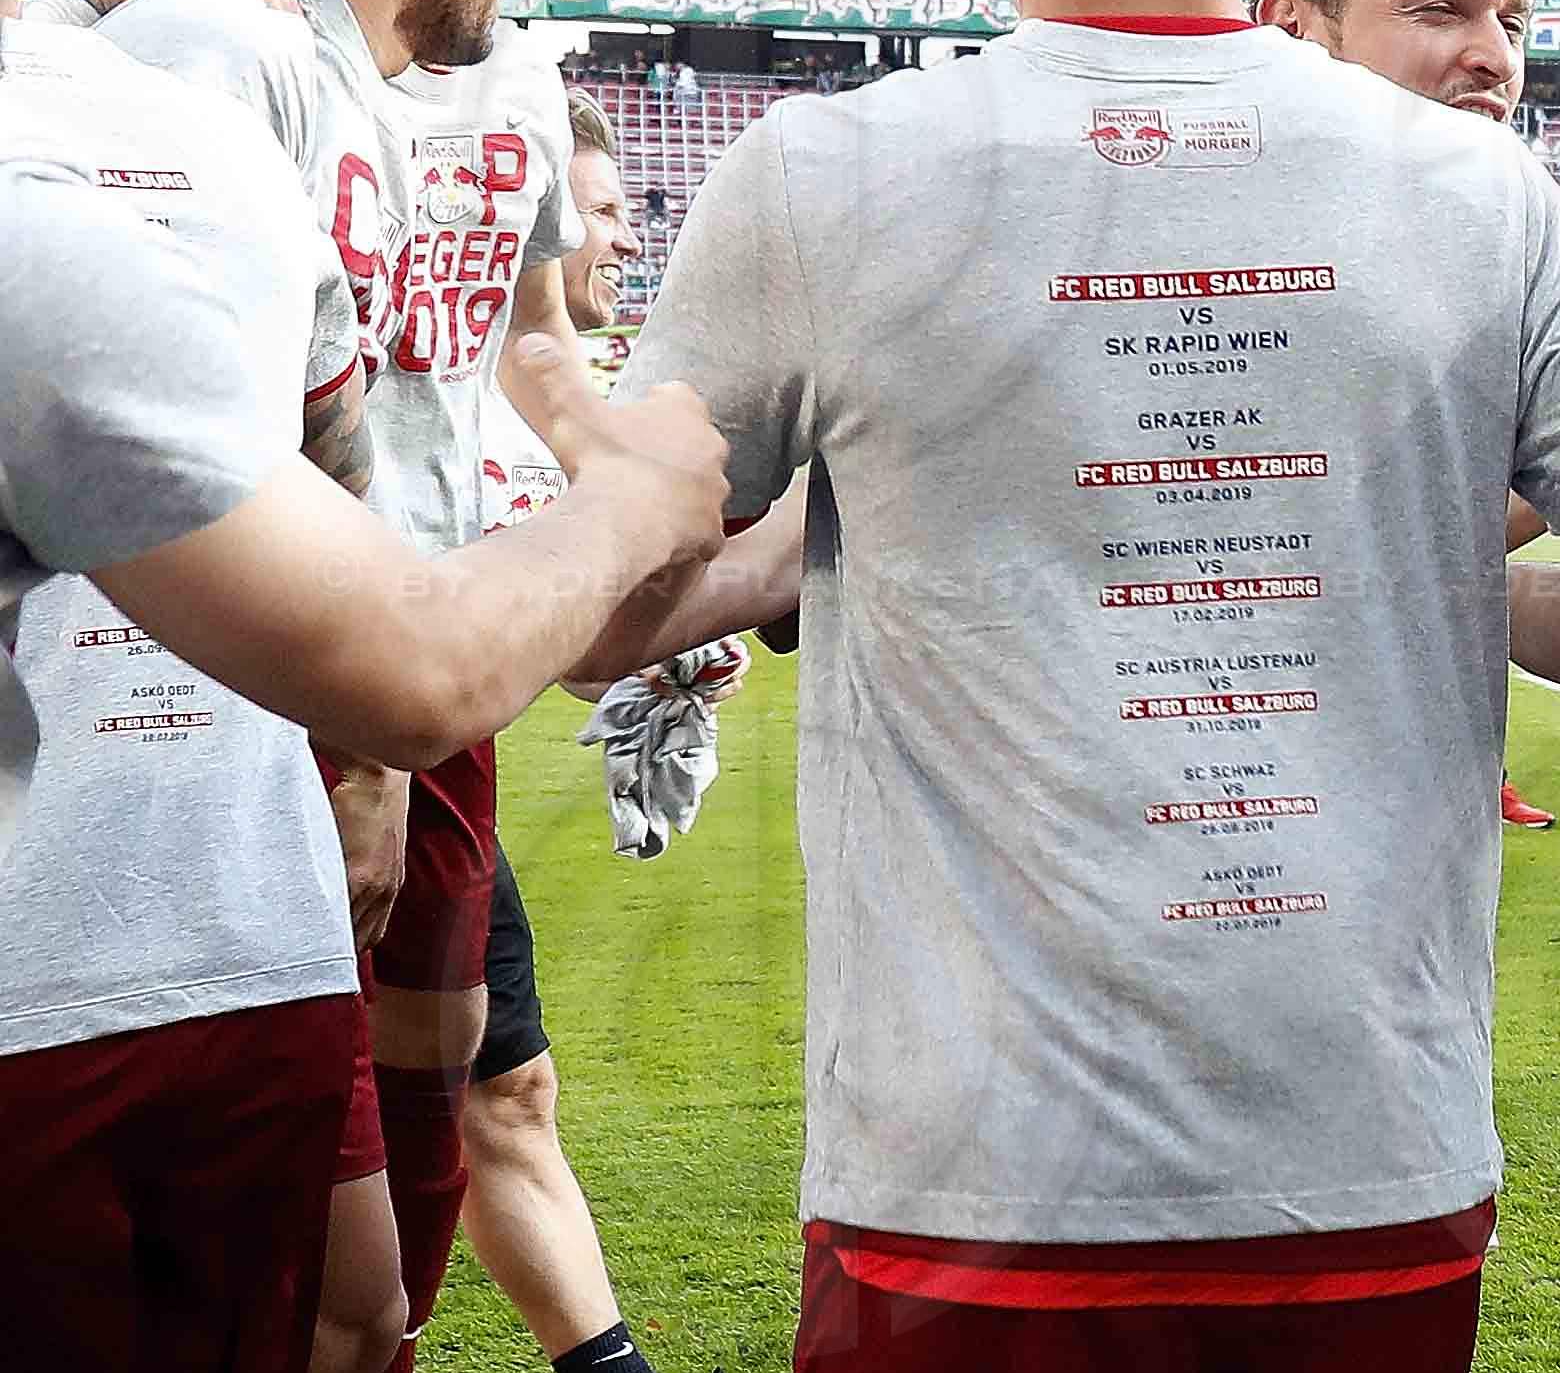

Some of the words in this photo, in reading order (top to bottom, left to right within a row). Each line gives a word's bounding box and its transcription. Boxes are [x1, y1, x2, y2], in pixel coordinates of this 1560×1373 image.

[1185, 137, 1250, 150] MORGEN
[1051, 278, 1080, 299] FC
[1089, 278, 1136, 298] RED
[1143, 276, 1202, 296] BULL
[1209, 270, 1332, 293] SALZBURG
[1180, 307, 1213, 325] VS
[396, 288, 506, 372] 019
[1106, 338, 1136, 356] SK
[1148, 335, 1218, 354] RAPID
[1229, 330, 1288, 350] WIEN
[1150, 358, 1247, 376] 01.05.2019
[1139, 411, 1225, 430] GRAZER
[1234, 409, 1263, 425] AK
[1187, 435, 1216, 450] VS
[1077, 466, 1105, 484] FC
[1112, 465, 1151, 483] RED
[1159, 461, 1211, 480] BULL
[1216, 457, 1325, 477] SALZBURG
[1157, 487, 1252, 505] 03.04.2019
[1103, 543, 1128, 558] SC
[1136, 539, 1207, 556] WIENER
[1214, 535, 1311, 553] NEUSTADT
[1197, 561, 1223, 573] VS
[1101, 589, 1126, 605] FC
[1131, 587, 1167, 603] RED
[1172, 584, 1218, 602] BULL
[1223, 579, 1318, 599] SALZBURG
[75, 633, 95, 645] FC
[98, 631, 125, 643] RED
[168, 685, 196, 695] OEDT
[159, 700, 173, 709] VS
[96, 720, 114, 731] FC
[117, 719, 141, 729] RED
[143, 717, 169, 728] BULL
